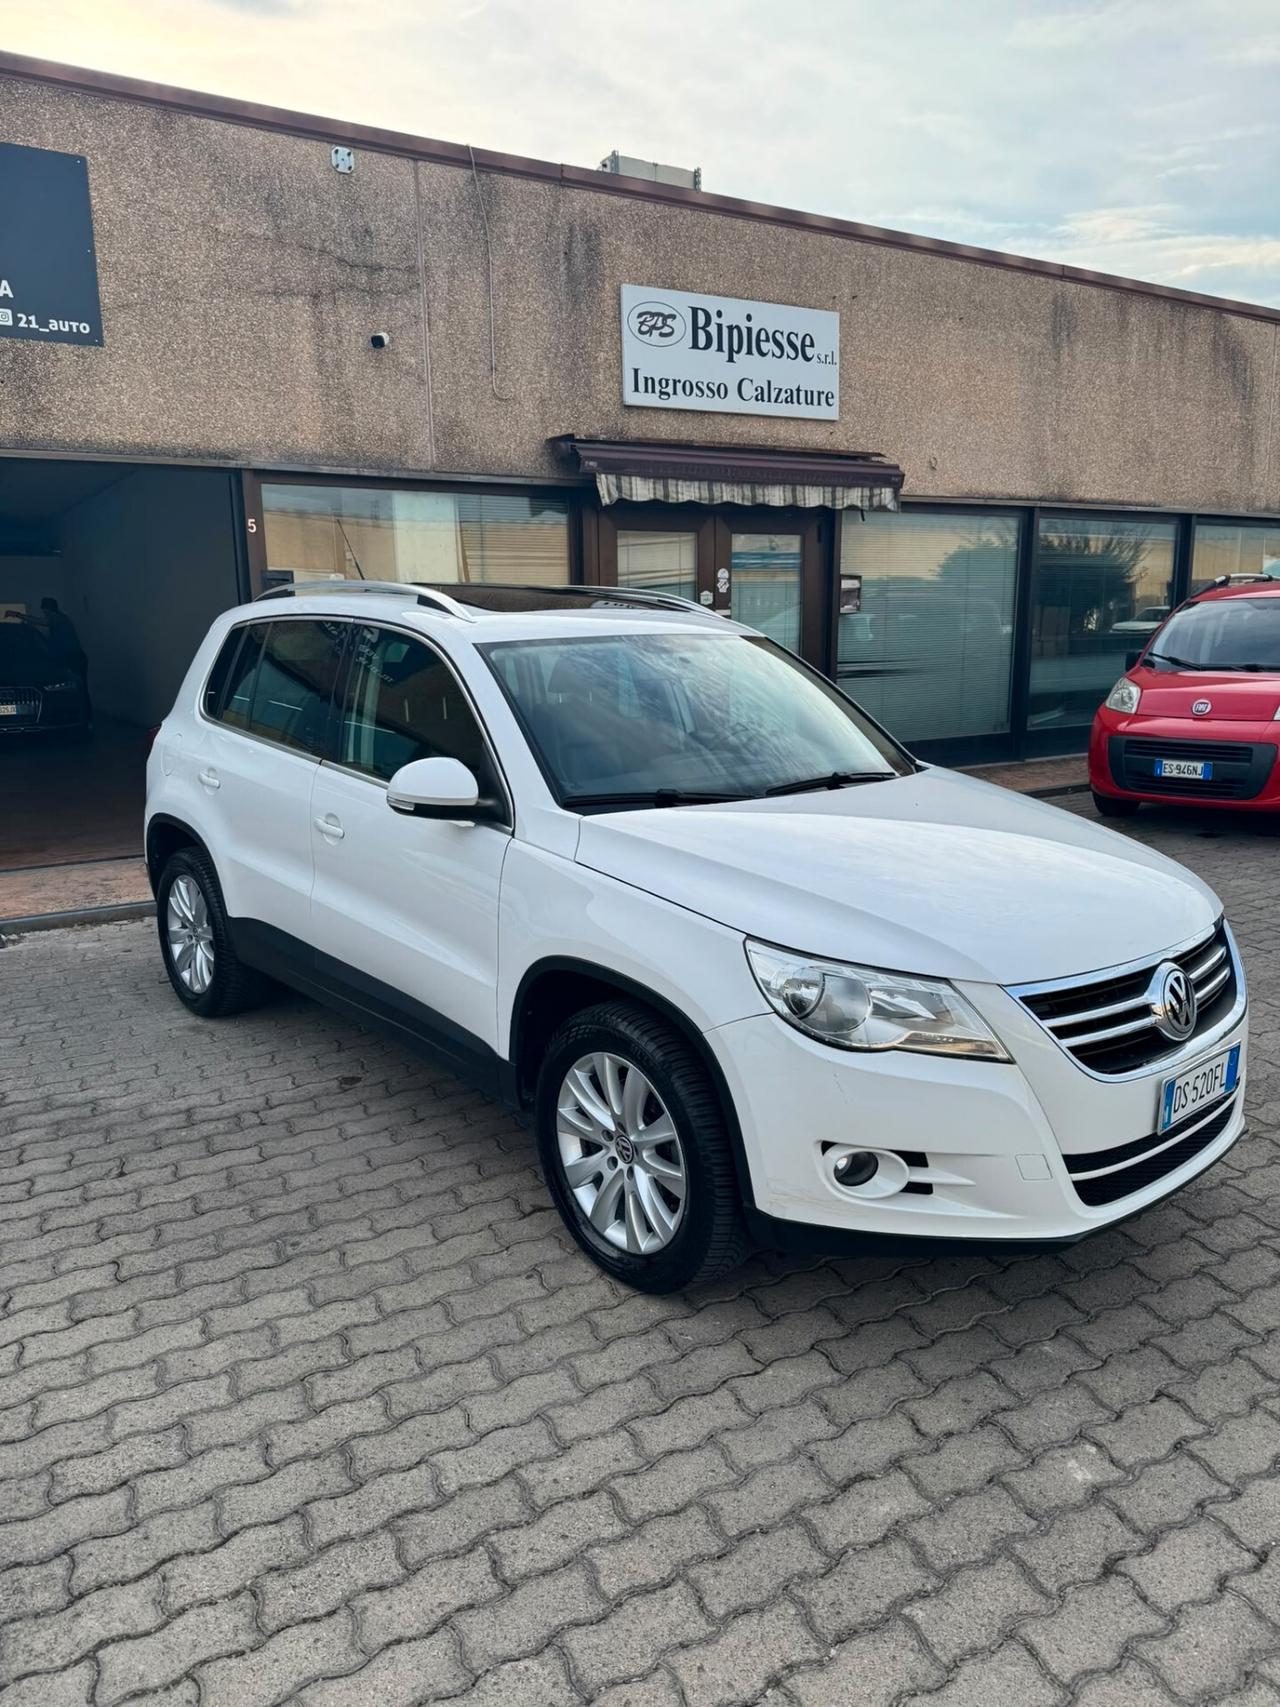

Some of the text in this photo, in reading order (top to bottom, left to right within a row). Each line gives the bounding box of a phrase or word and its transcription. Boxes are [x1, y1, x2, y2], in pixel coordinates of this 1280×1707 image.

[688, 306, 838, 366] Bipiesse s.r.l.
[632, 367, 835, 407] Ingrosso Calzature
[247, 518, 257, 533] 5
[1163, 763, 1174, 774] ES
[1191, 1062, 1225, 1103] 520FL
